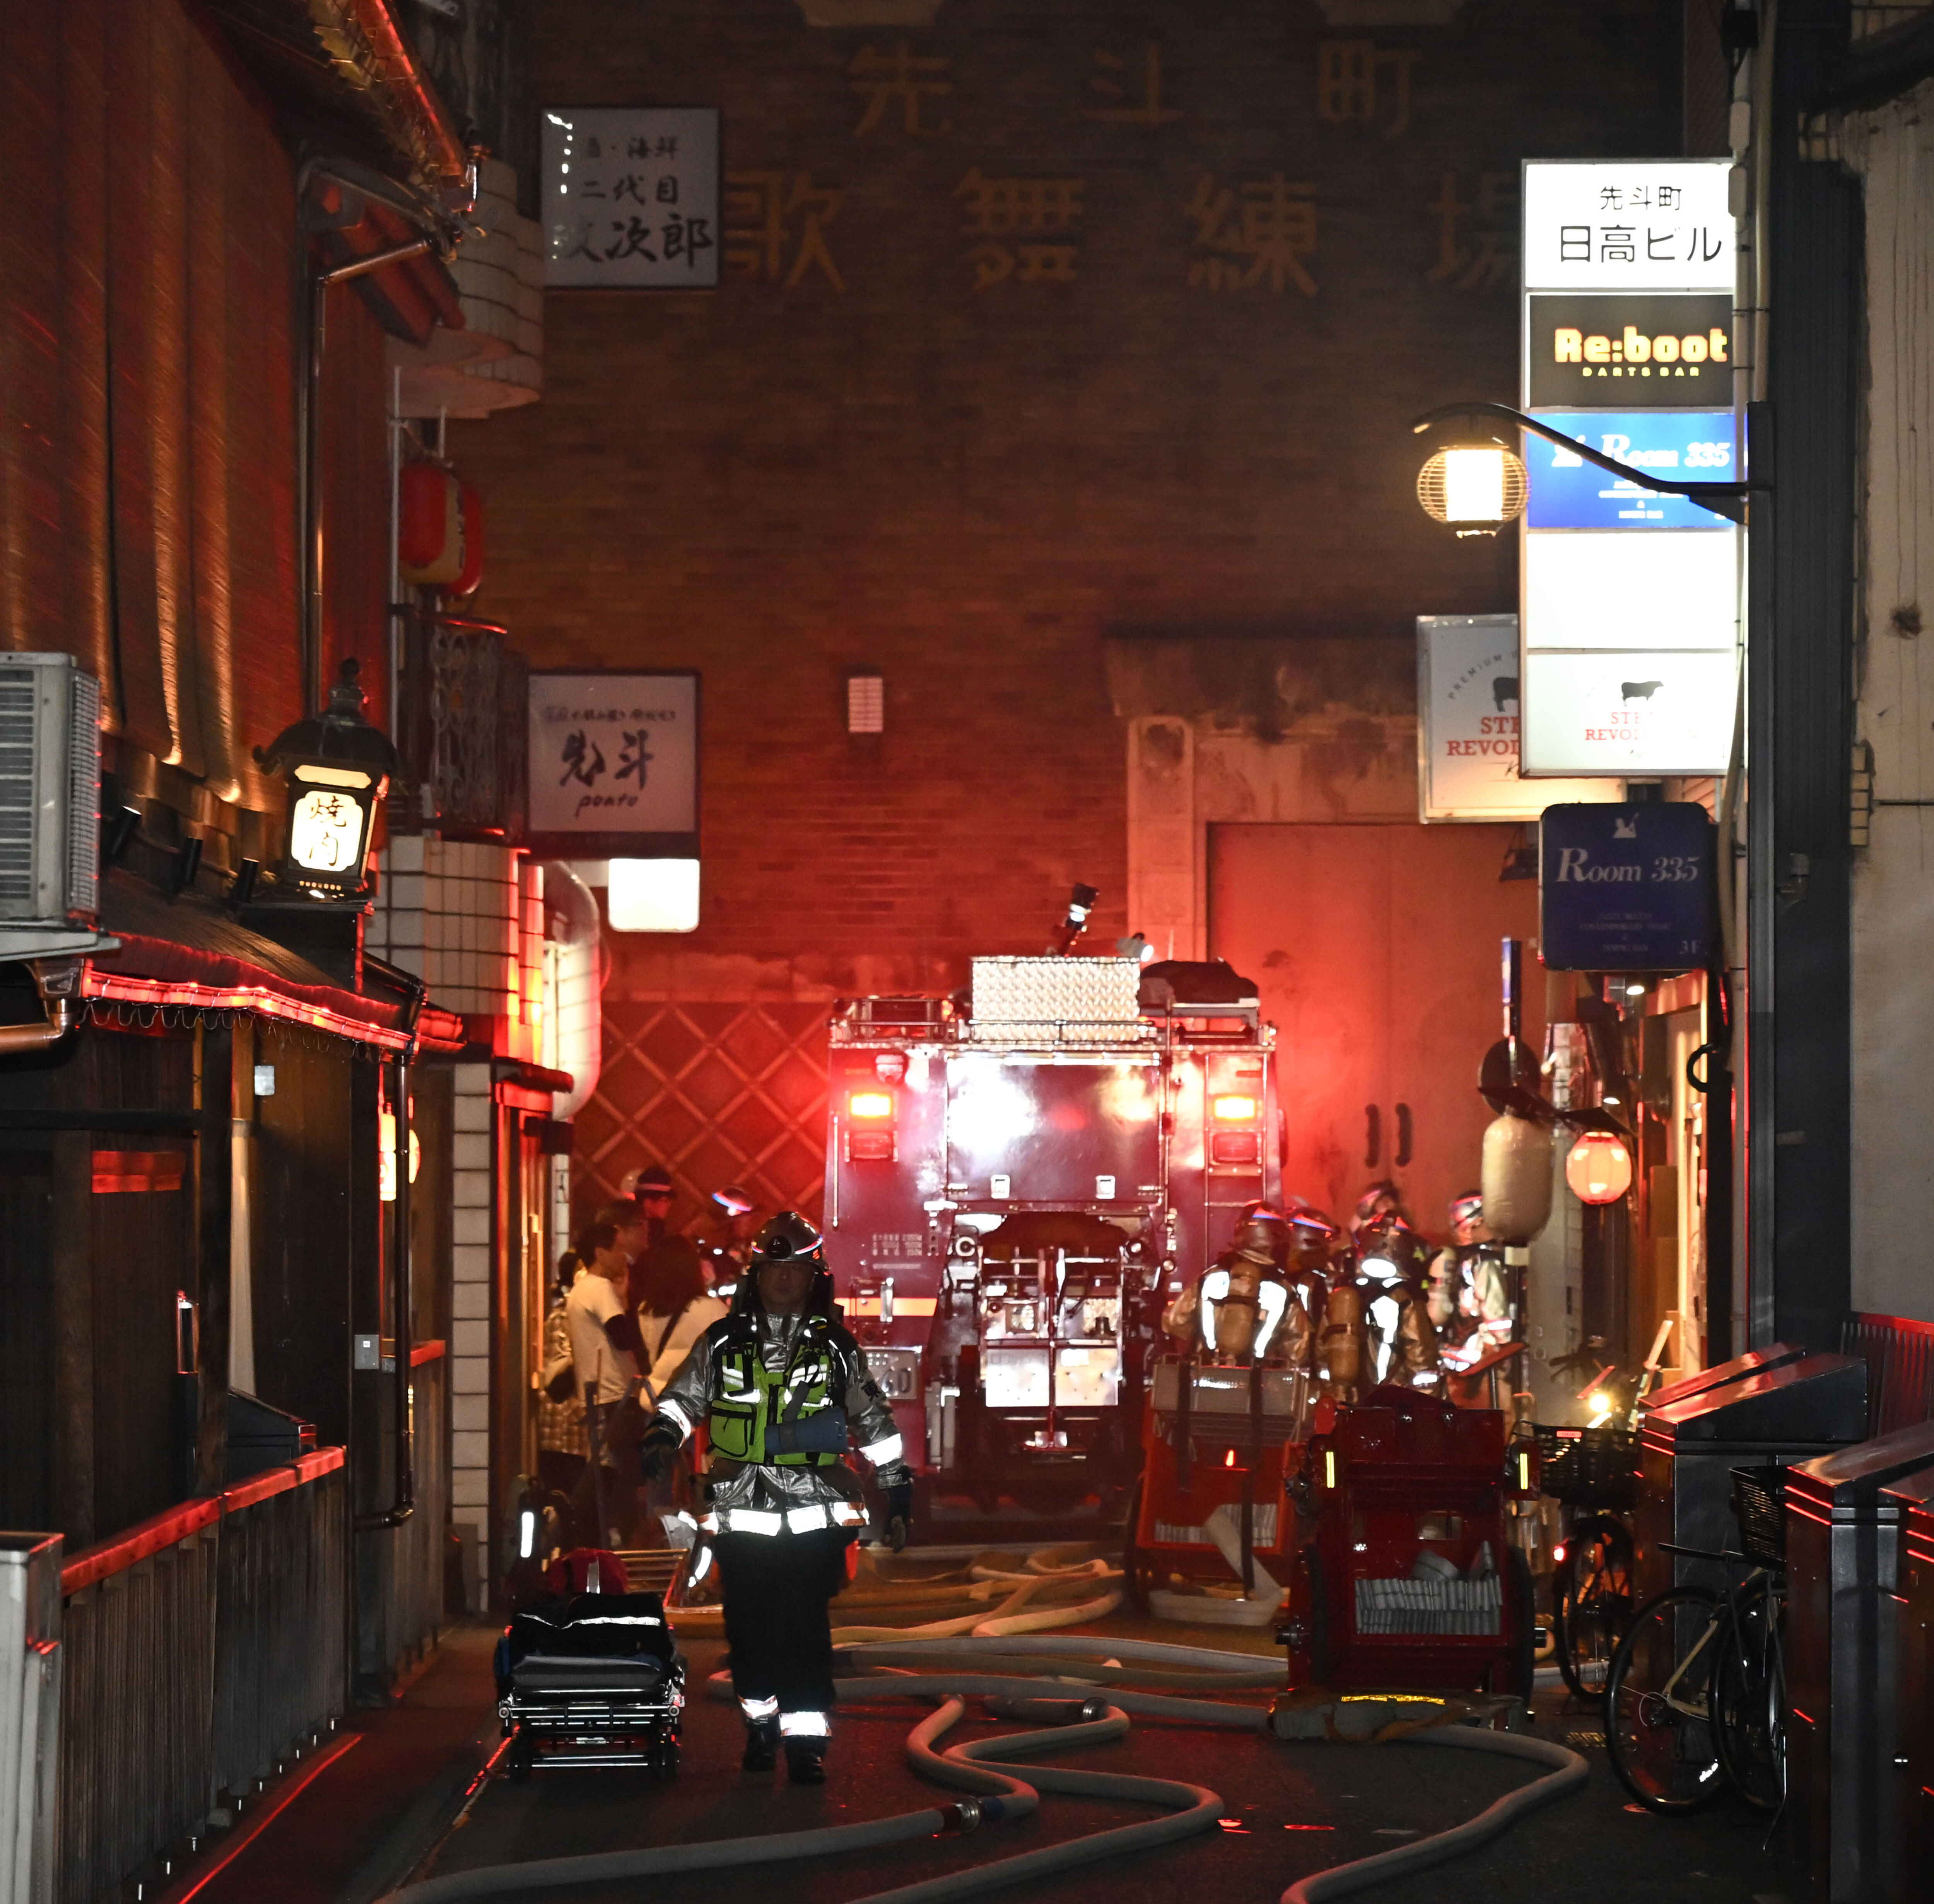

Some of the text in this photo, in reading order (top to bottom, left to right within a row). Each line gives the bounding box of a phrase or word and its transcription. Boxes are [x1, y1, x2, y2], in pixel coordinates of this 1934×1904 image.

[846, 39, 1424, 141] 先斗町
[581, 175, 678, 205] 二代目
[1600, 185, 1682, 210] 先斗町
[1560, 224, 1722, 263] 日高ビル
[1554, 326, 1728, 363] Re:boot
[1582, 367, 1699, 377] DARTS BAR
[1684, 442, 1731, 468] 335
[1556, 847, 1700, 882] Room 335
